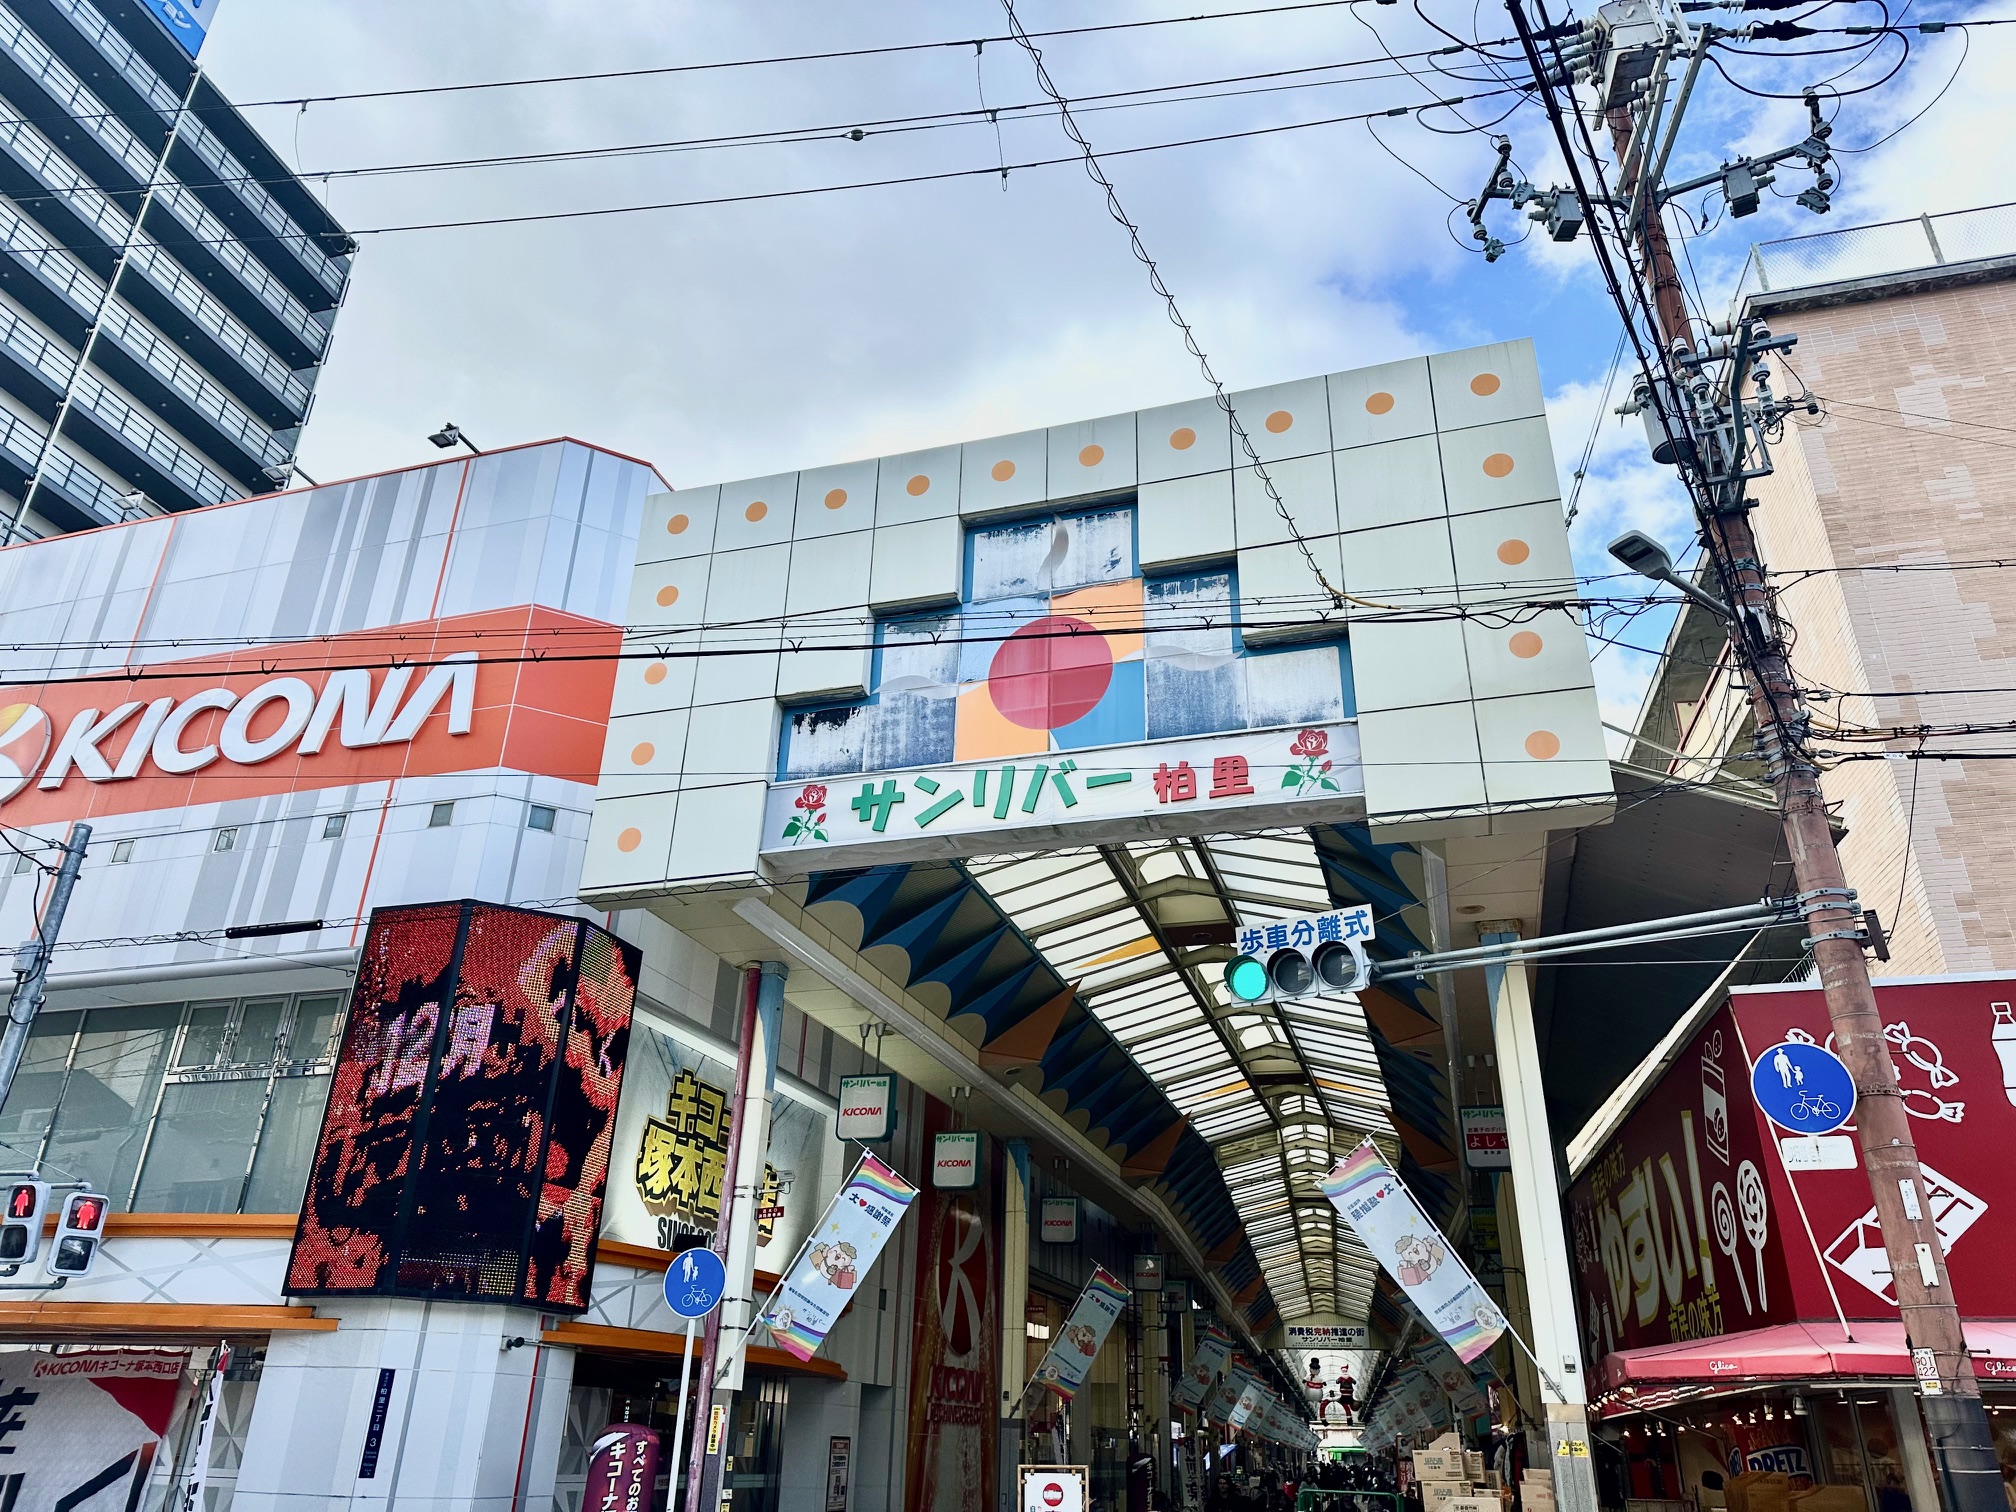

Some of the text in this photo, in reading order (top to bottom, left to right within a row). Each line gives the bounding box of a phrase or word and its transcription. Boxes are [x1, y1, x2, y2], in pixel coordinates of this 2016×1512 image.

[37, 651, 478, 790] KICONA
[851, 754, 1255, 833] サンリバー 柏里
[1241, 910, 1369, 955] 歩車分離式
[843, 1106, 882, 1116] KICONA
[937, 1159, 972, 1168] KICONA
[1591, 1142, 1627, 1200] 市民の味方
[1288, 1326, 1365, 1337] 消費税完納推進の街
[1667, 1284, 1724, 1343] 市民の味方
[1709, 1360, 1738, 1375] Glico
[600, 1442, 627, 1512] キコーナ
[625, 1440, 649, 1512] すべてのお
